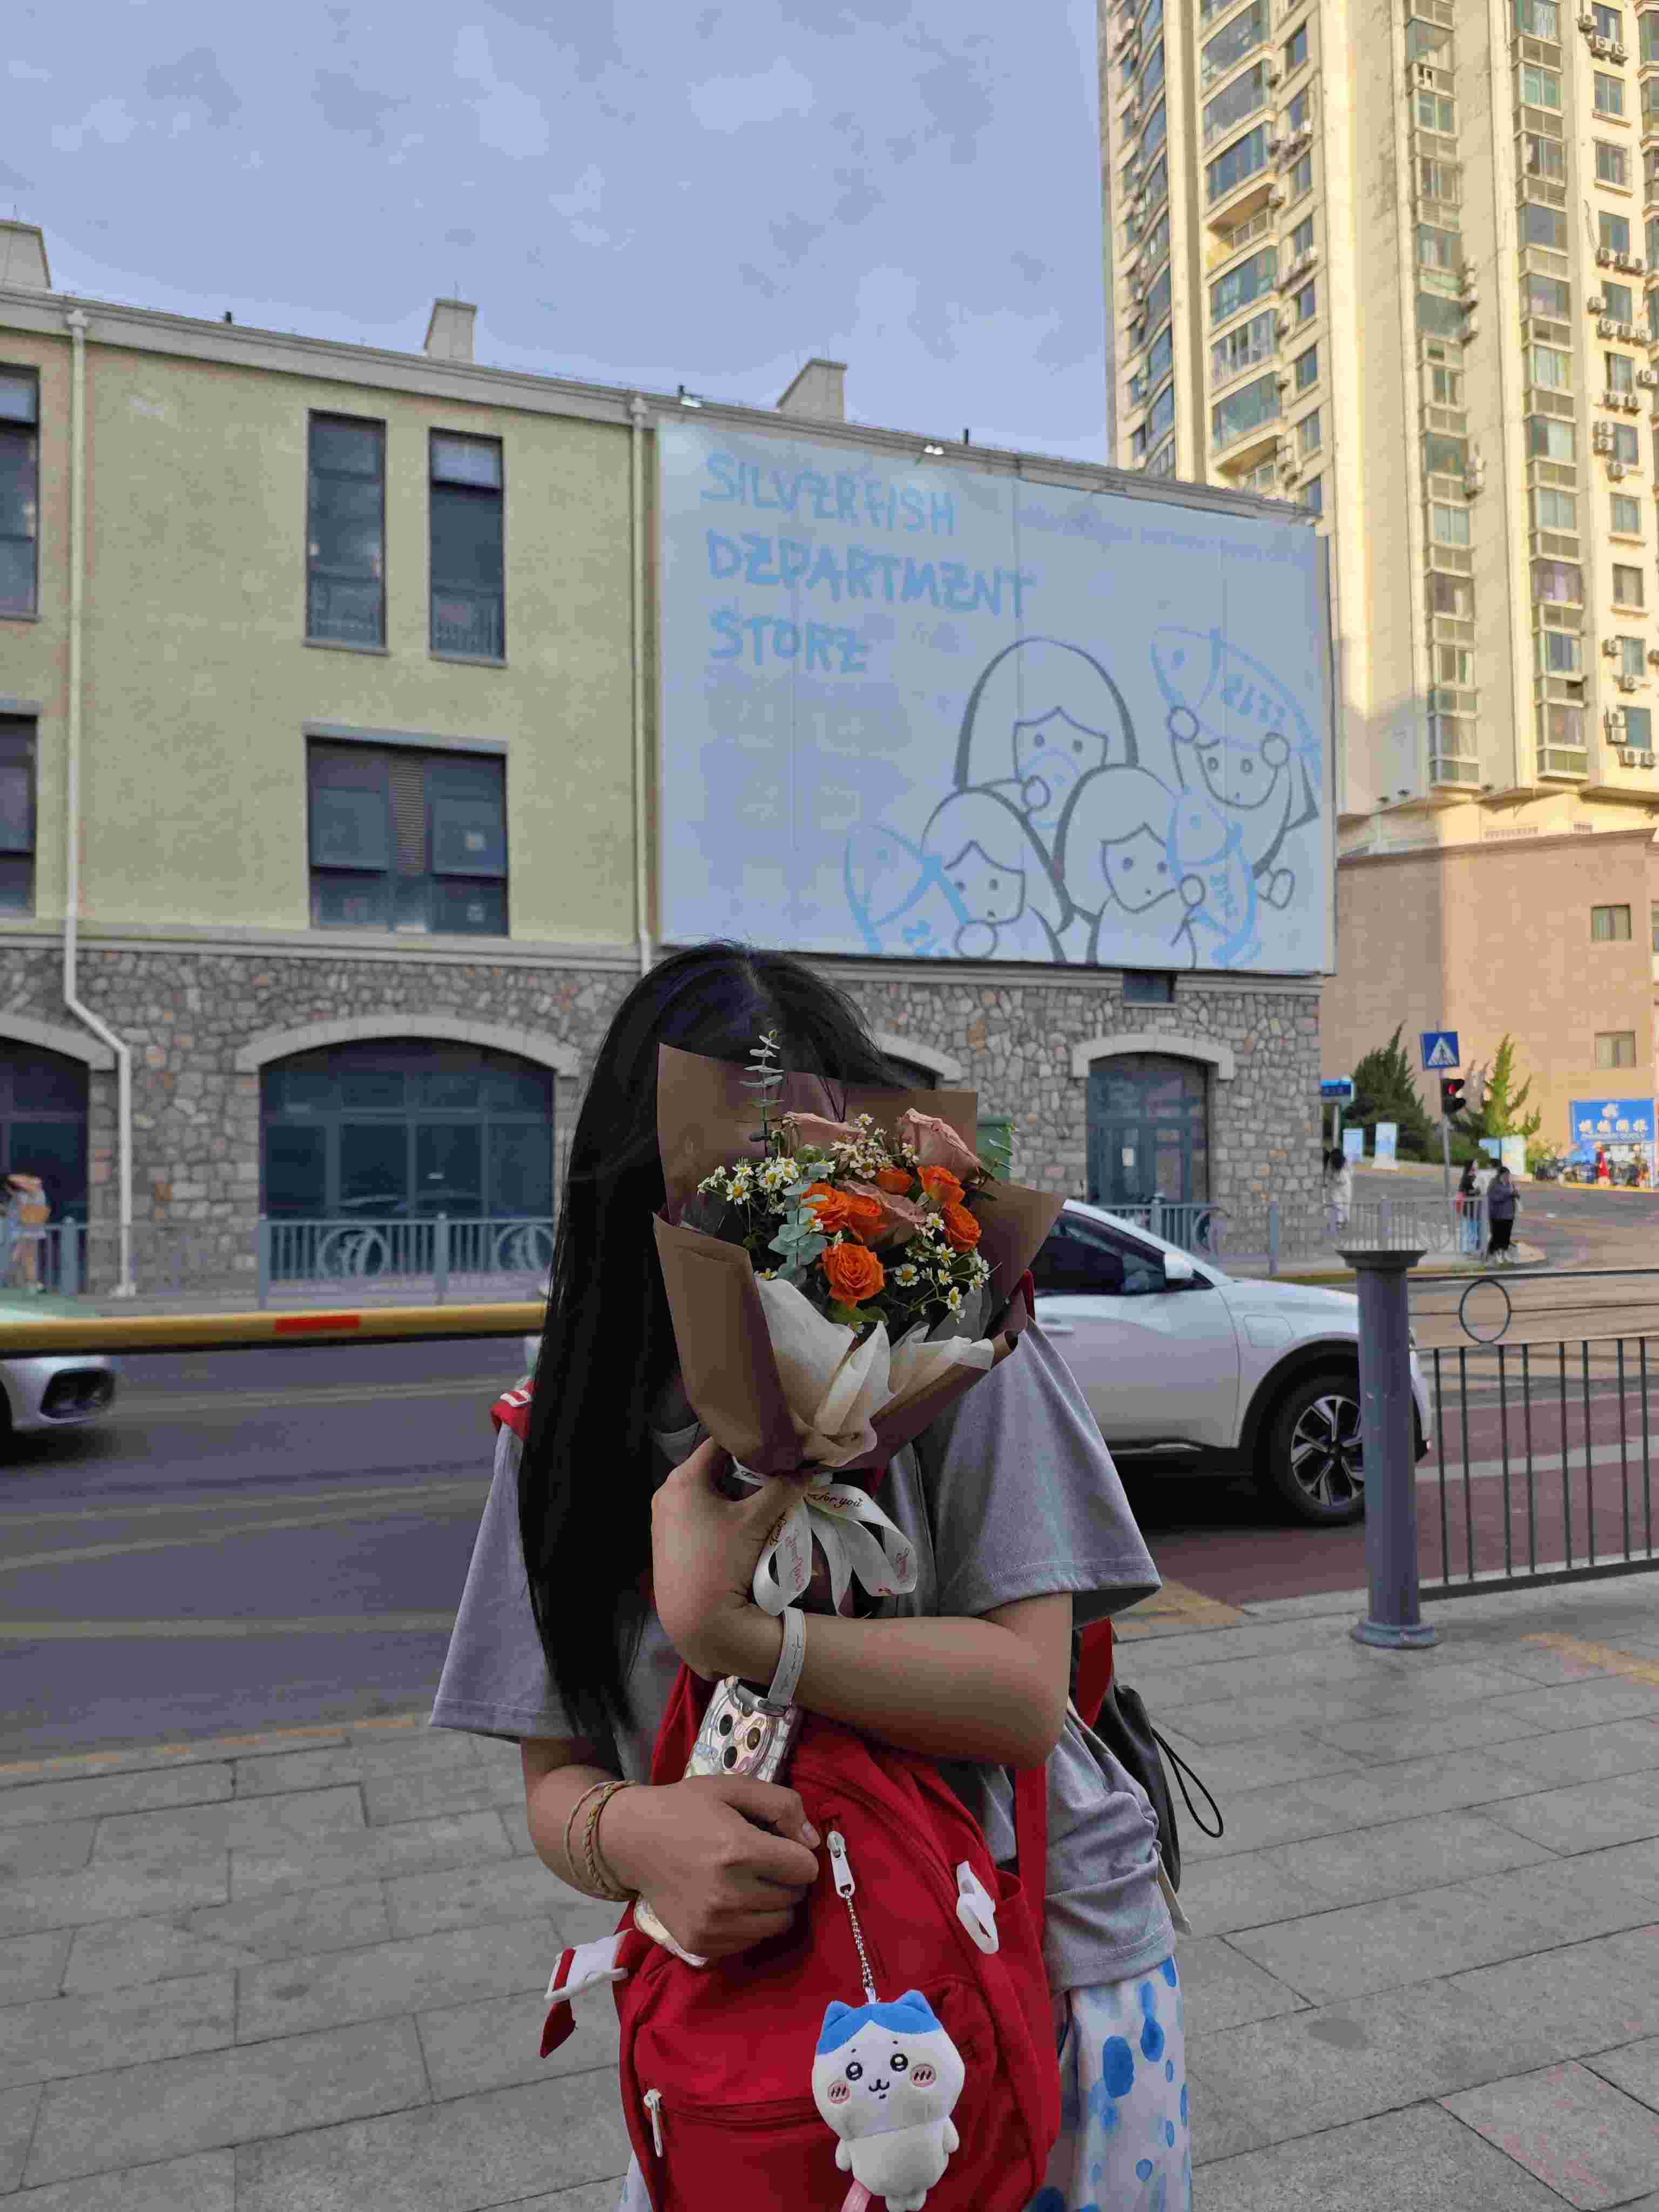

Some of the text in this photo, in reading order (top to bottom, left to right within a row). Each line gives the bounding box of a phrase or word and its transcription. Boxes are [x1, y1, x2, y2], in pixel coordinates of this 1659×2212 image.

[702, 449, 956, 535] SILVERFISH
[706, 529, 1037, 618] DEPARTMENT
[709, 604, 868, 673] STORE
